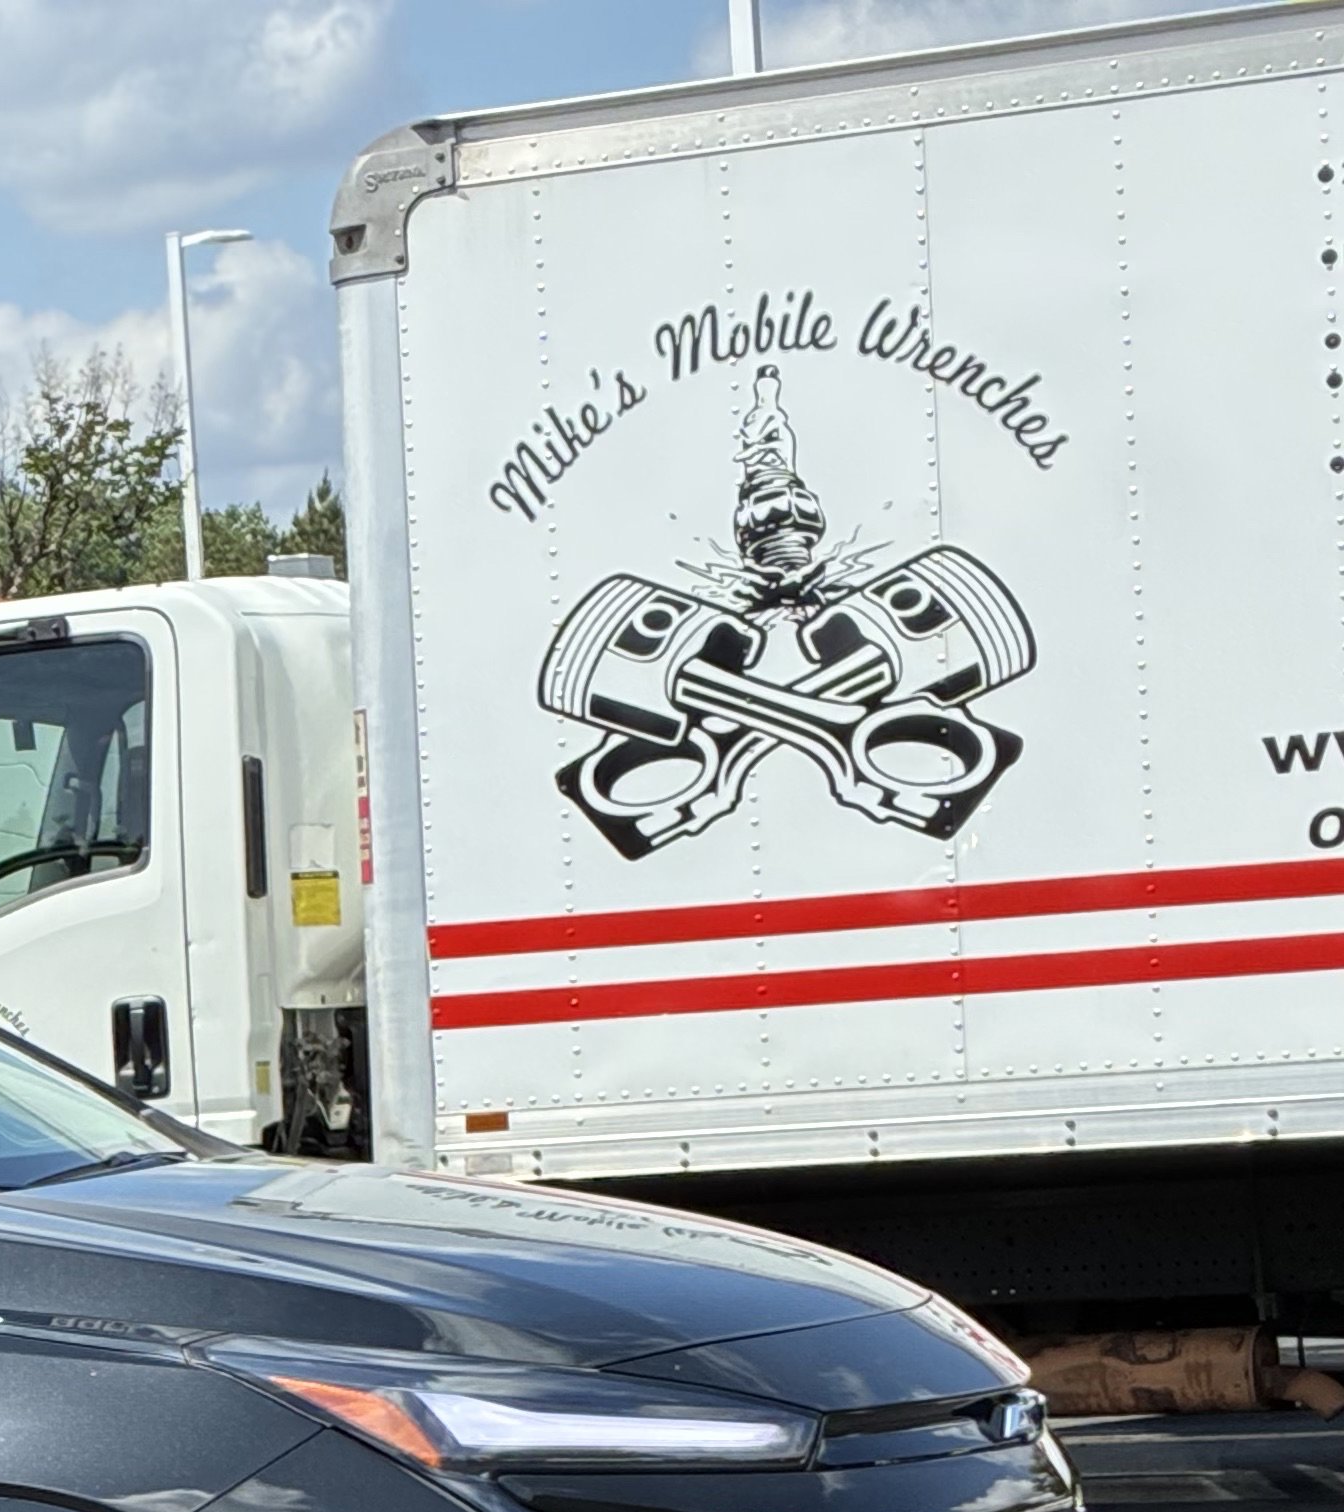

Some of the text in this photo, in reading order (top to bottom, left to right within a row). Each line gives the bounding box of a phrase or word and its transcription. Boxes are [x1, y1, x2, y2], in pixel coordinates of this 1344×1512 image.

[489, 290, 1069, 523] Mike's Mobile Wrenches
[1262, 731, 1344, 774] w
